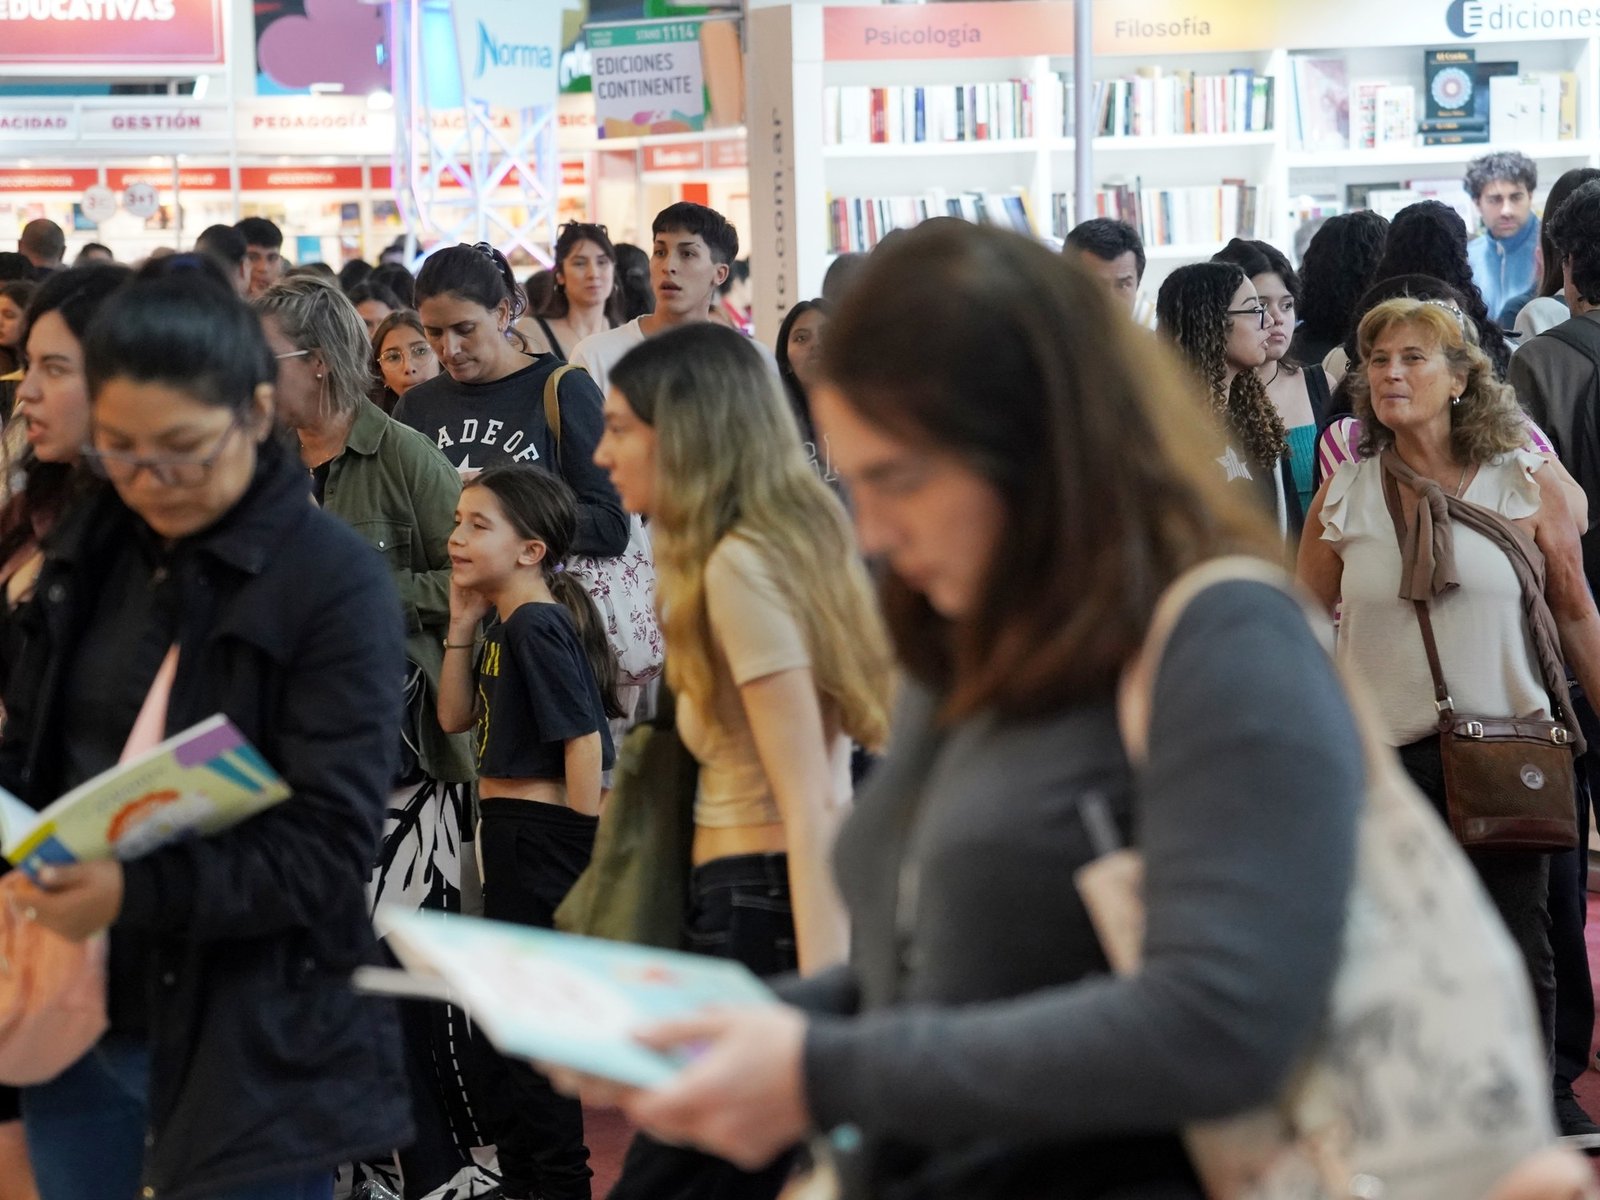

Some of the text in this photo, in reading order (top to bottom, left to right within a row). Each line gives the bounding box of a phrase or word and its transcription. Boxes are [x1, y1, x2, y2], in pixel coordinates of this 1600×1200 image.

[662, 23, 694, 41] 1114
[864, 22, 981, 47] Psicología
[1115, 16, 1211, 38] Filosofía
[474, 18, 552, 78] Norma
[596, 53, 673, 75] EDICIONES
[598, 75, 692, 99] CONTINENTE
[112, 109, 201, 130] GESTIÓN
